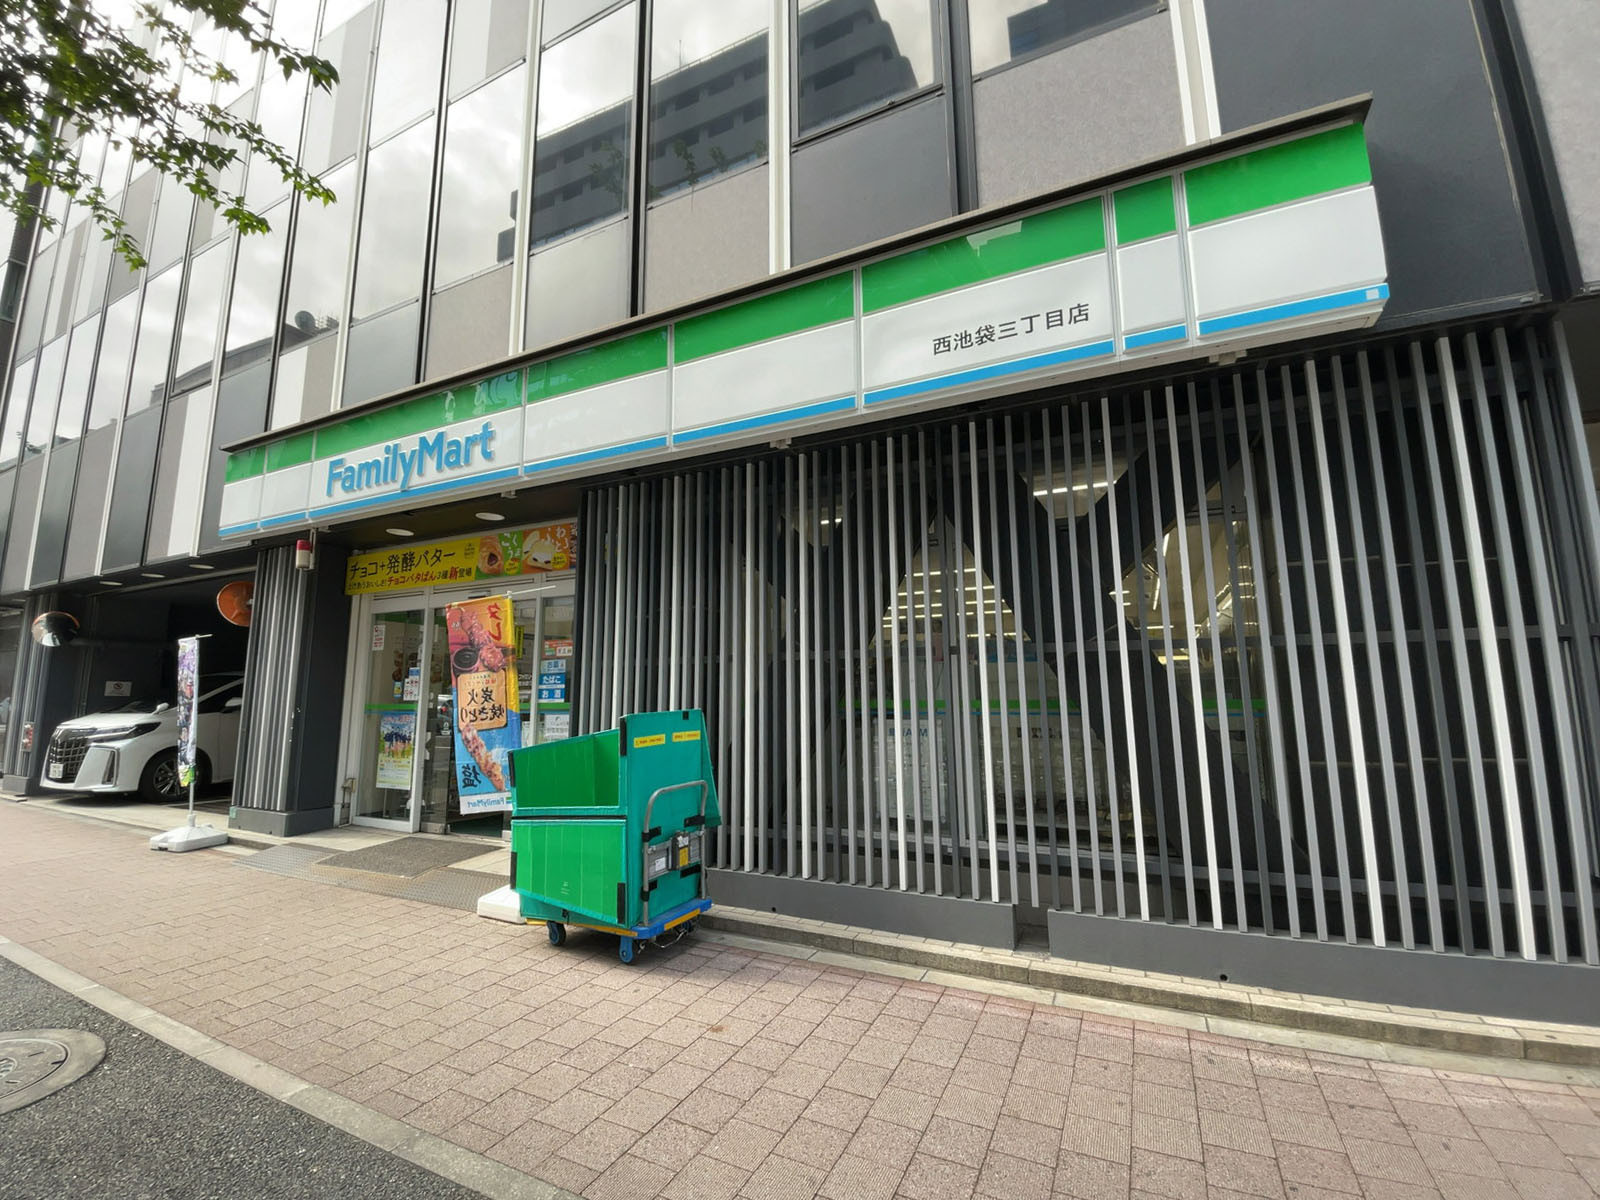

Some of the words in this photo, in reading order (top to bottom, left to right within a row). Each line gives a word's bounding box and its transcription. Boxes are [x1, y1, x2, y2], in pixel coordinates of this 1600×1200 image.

[933, 303, 1090, 356] 西池袋三丁目店
[326, 421, 495, 497] FamilyMart
